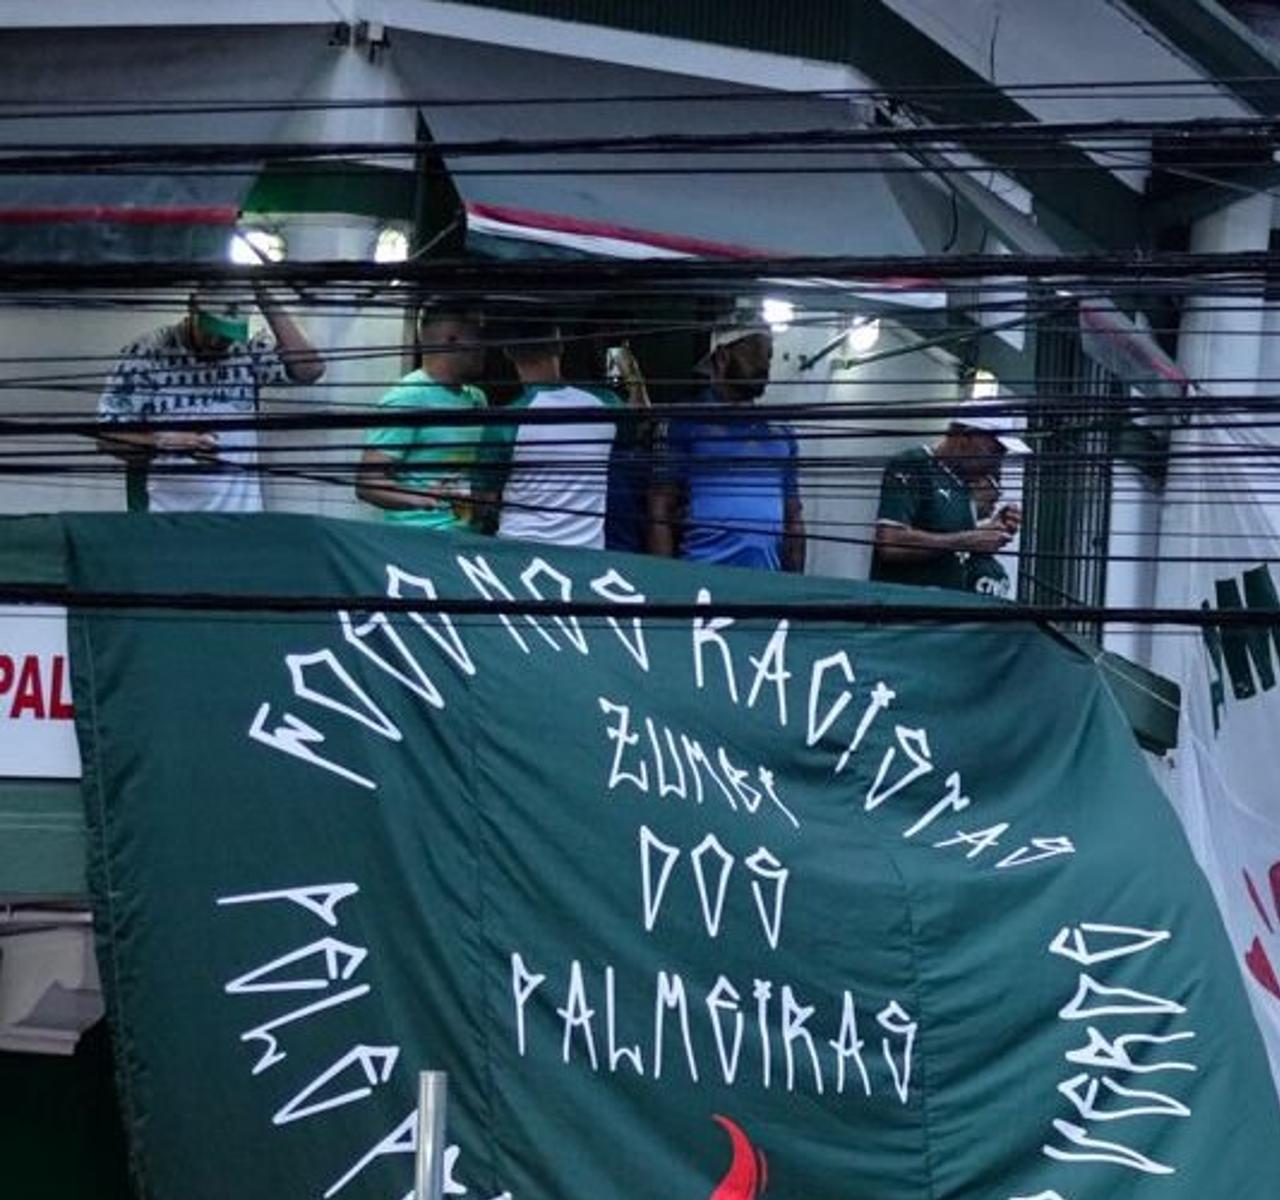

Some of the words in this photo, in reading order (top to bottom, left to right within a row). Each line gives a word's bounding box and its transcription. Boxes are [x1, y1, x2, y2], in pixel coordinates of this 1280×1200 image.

[457, 555, 651, 672] NOS
[600, 697, 801, 829] ZUMBI
[639, 825, 790, 951] DOS
[217, 883, 400, 1126] PELE
[511, 953, 919, 1105] PALMEIRAS
